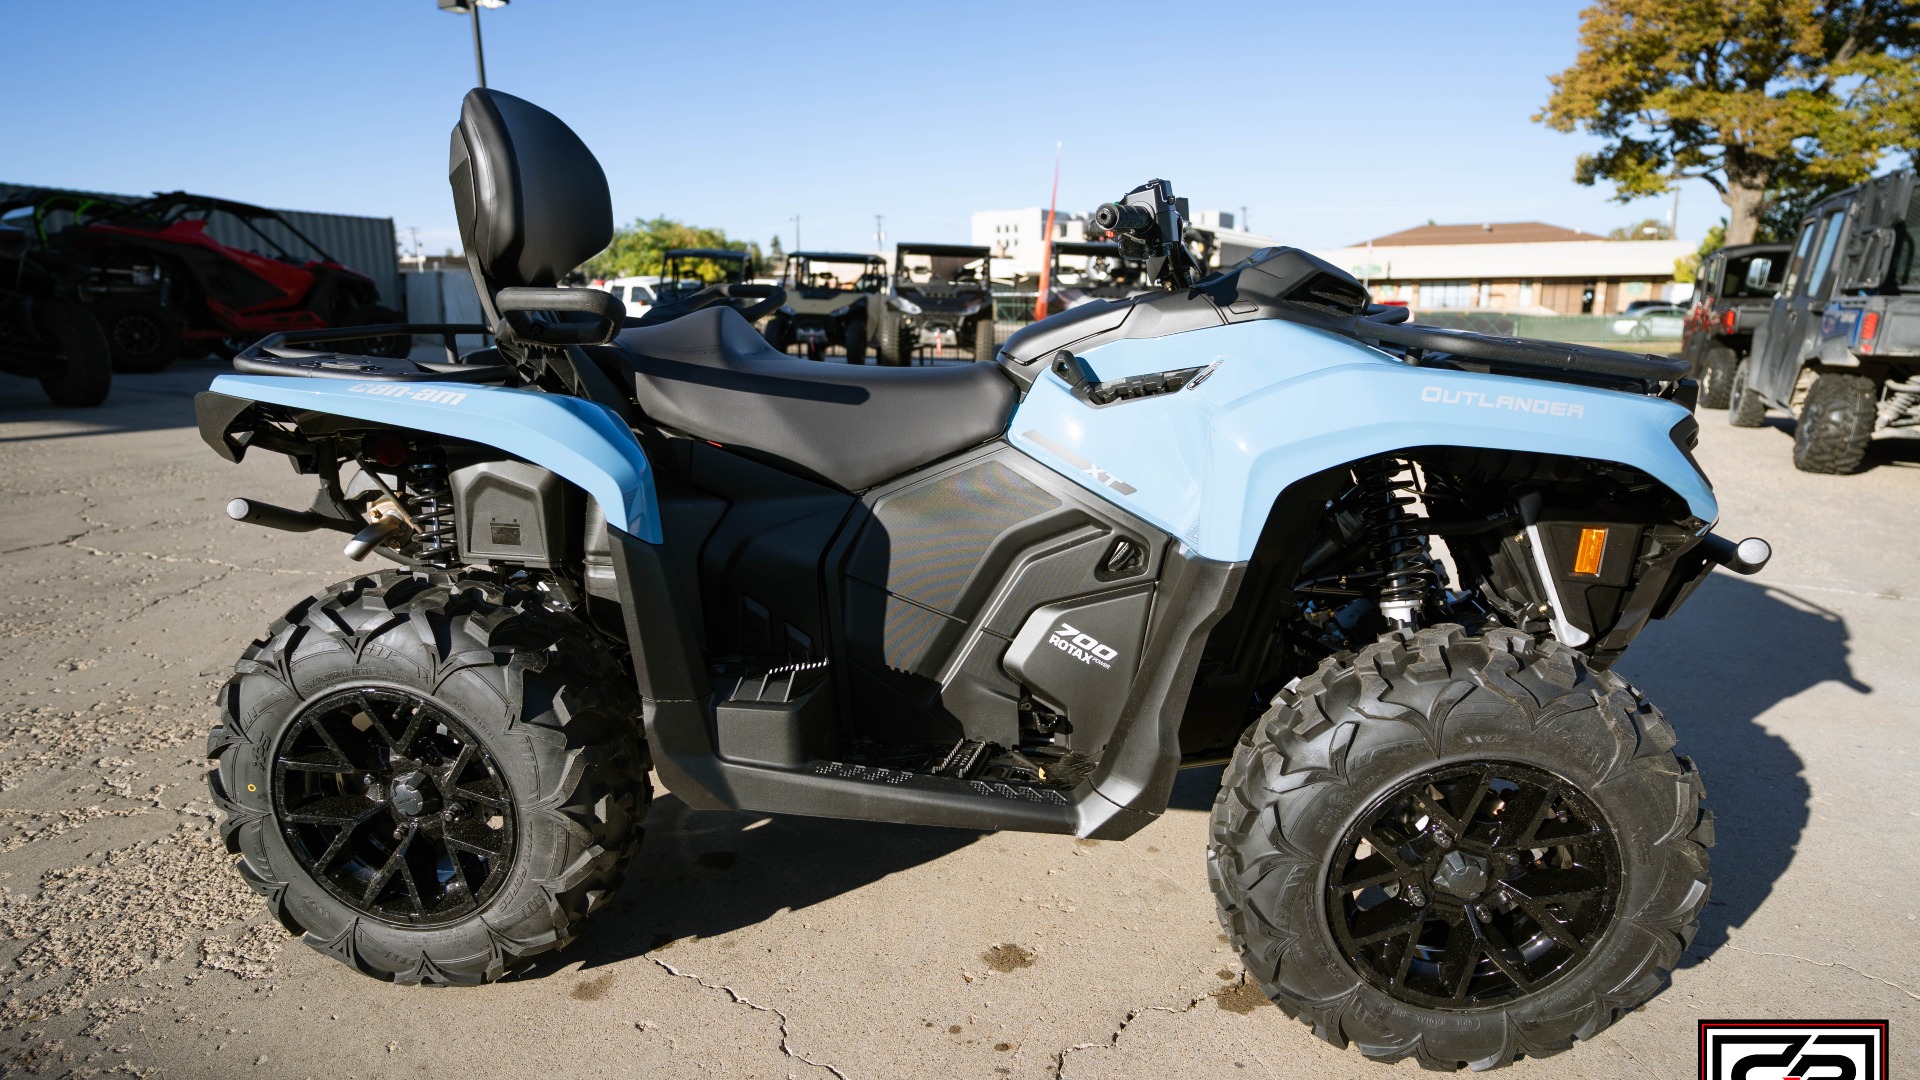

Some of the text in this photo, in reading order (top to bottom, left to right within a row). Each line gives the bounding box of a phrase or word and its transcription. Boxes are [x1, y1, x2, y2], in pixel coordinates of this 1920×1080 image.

[347, 382, 467, 405] can-am
[1420, 386, 1585, 418] OUTLANDER
[1083, 463, 1124, 486] XT
[1048, 633, 1111, 670] ROTAX POWER
[1054, 622, 1118, 661] 700
[499, 865, 528, 912] FORCE
